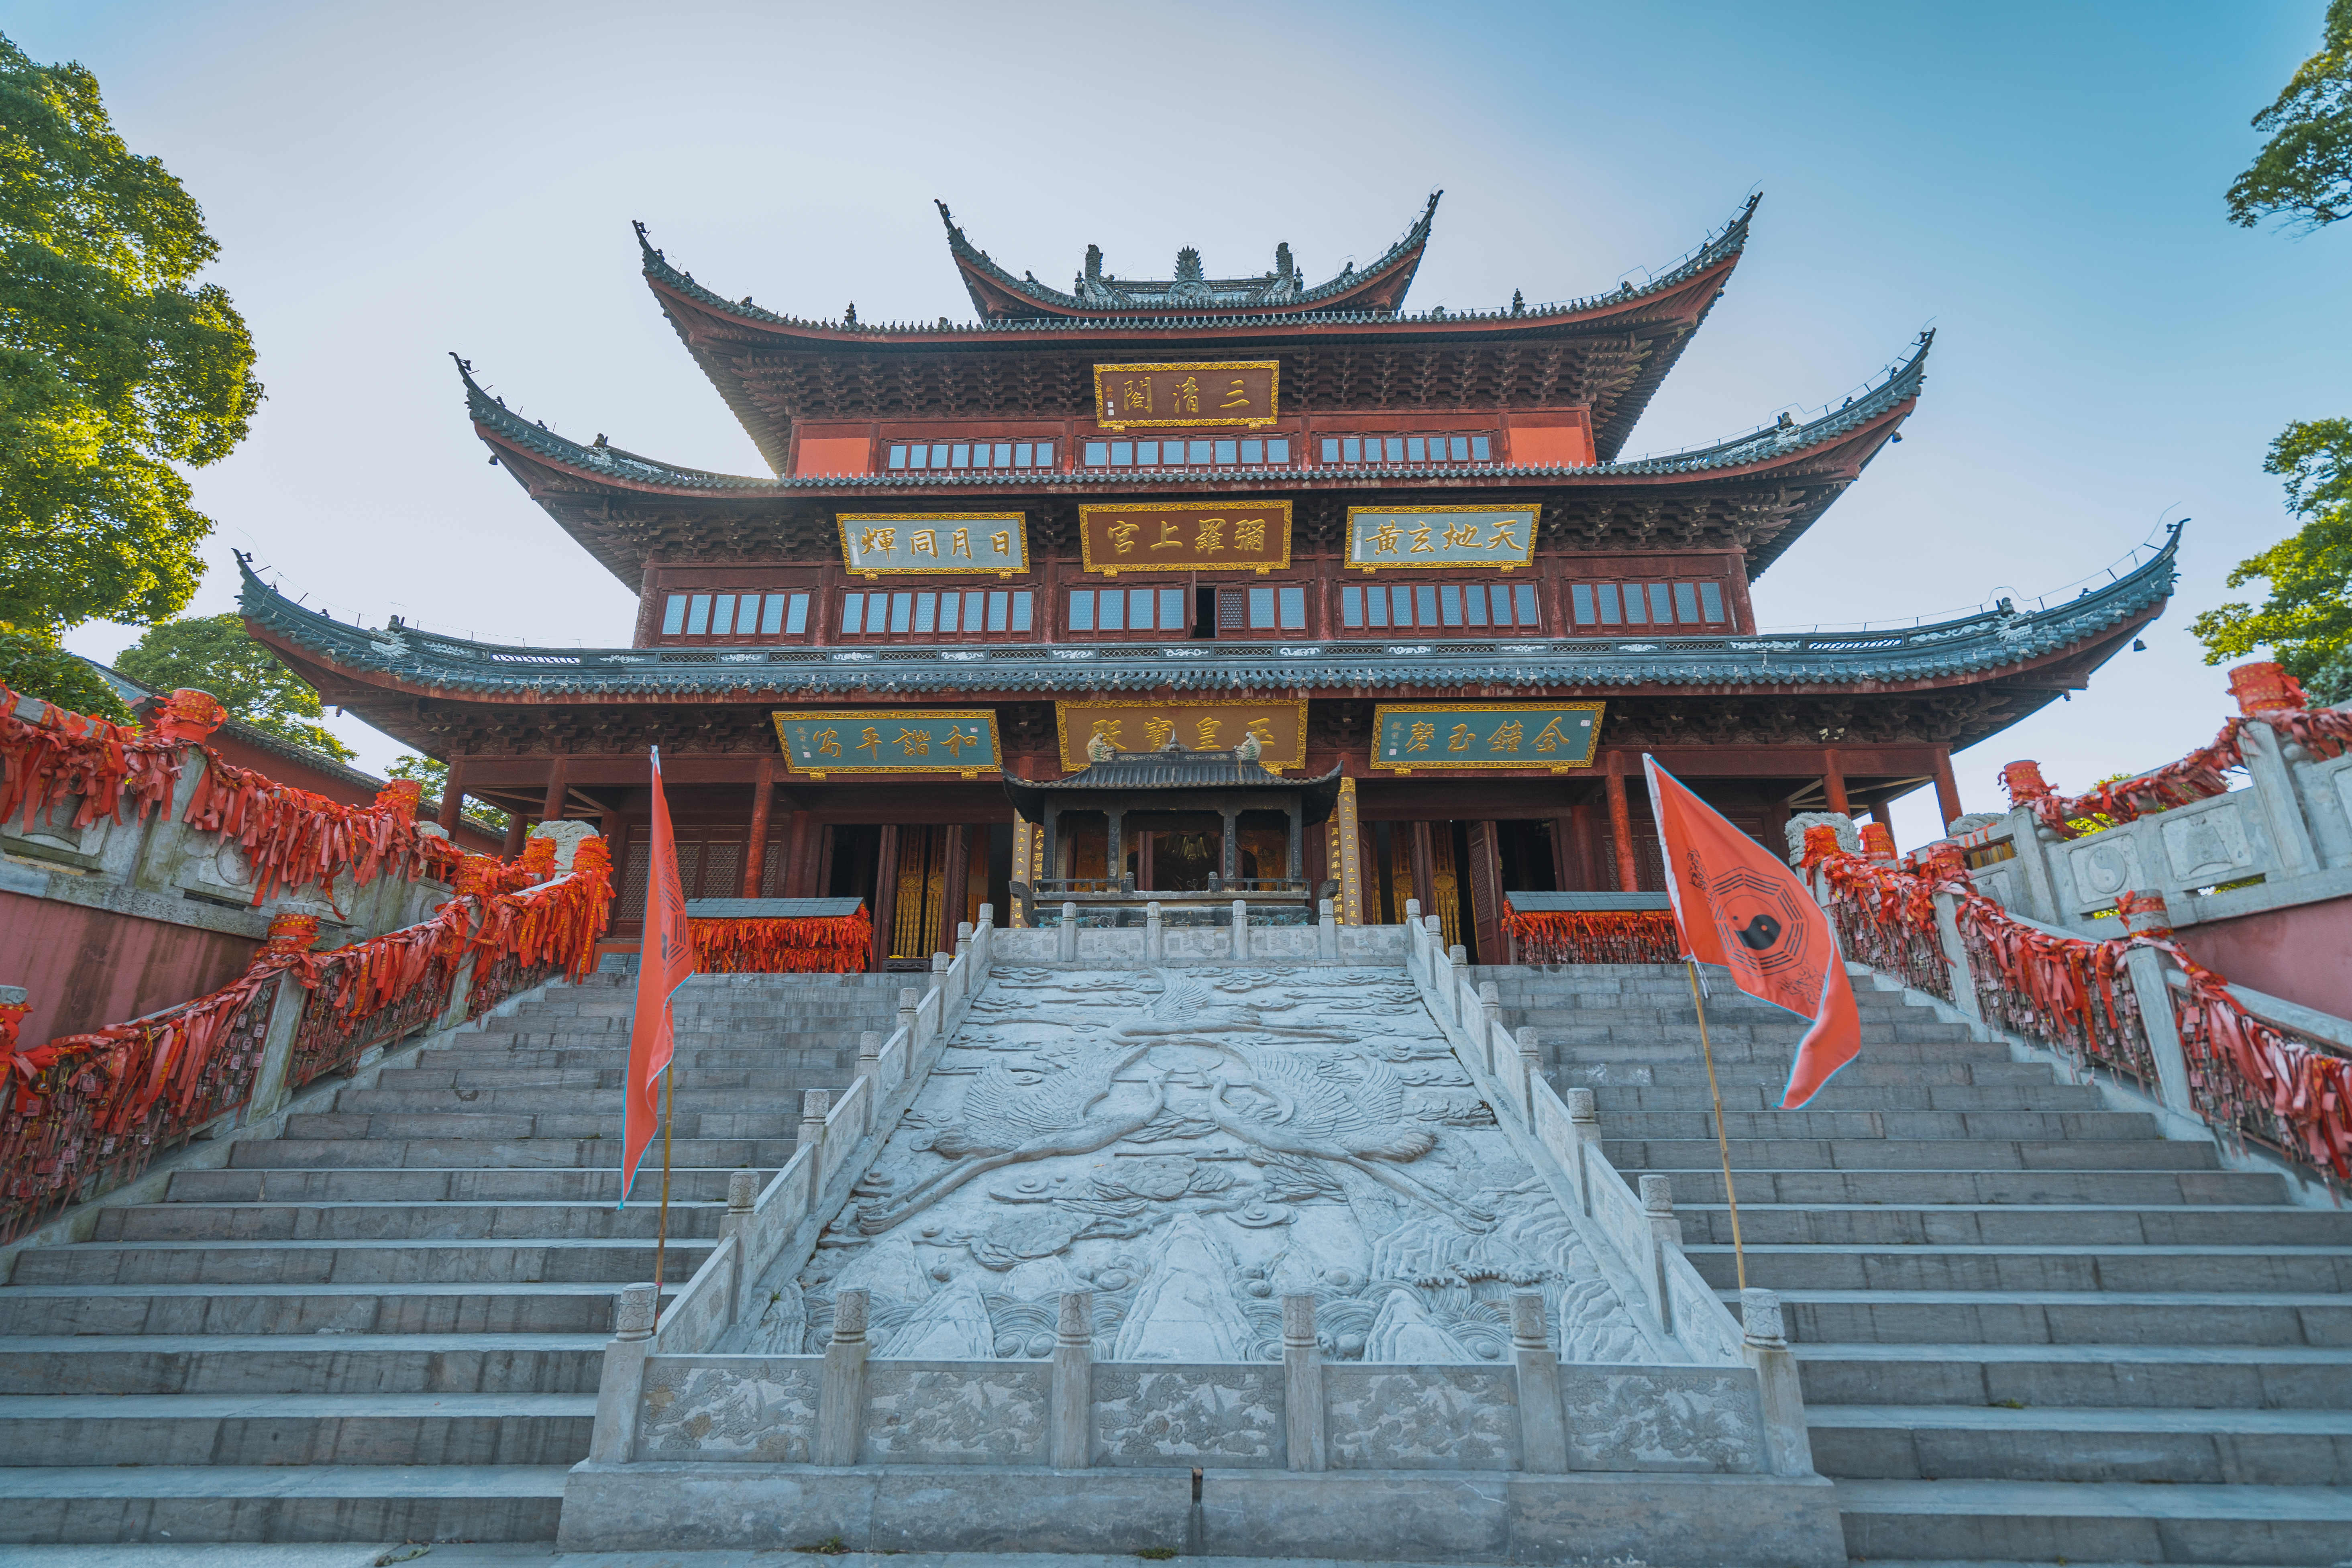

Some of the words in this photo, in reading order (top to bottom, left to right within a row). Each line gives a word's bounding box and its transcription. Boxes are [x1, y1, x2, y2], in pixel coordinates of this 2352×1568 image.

[1123, 376, 1250, 414] 三清閣
[1107, 517, 1266, 555] 彌羅上宮
[812, 725, 978, 761] 和諧平安
[1085, 716, 1276, 752] 玉皇寶殿
